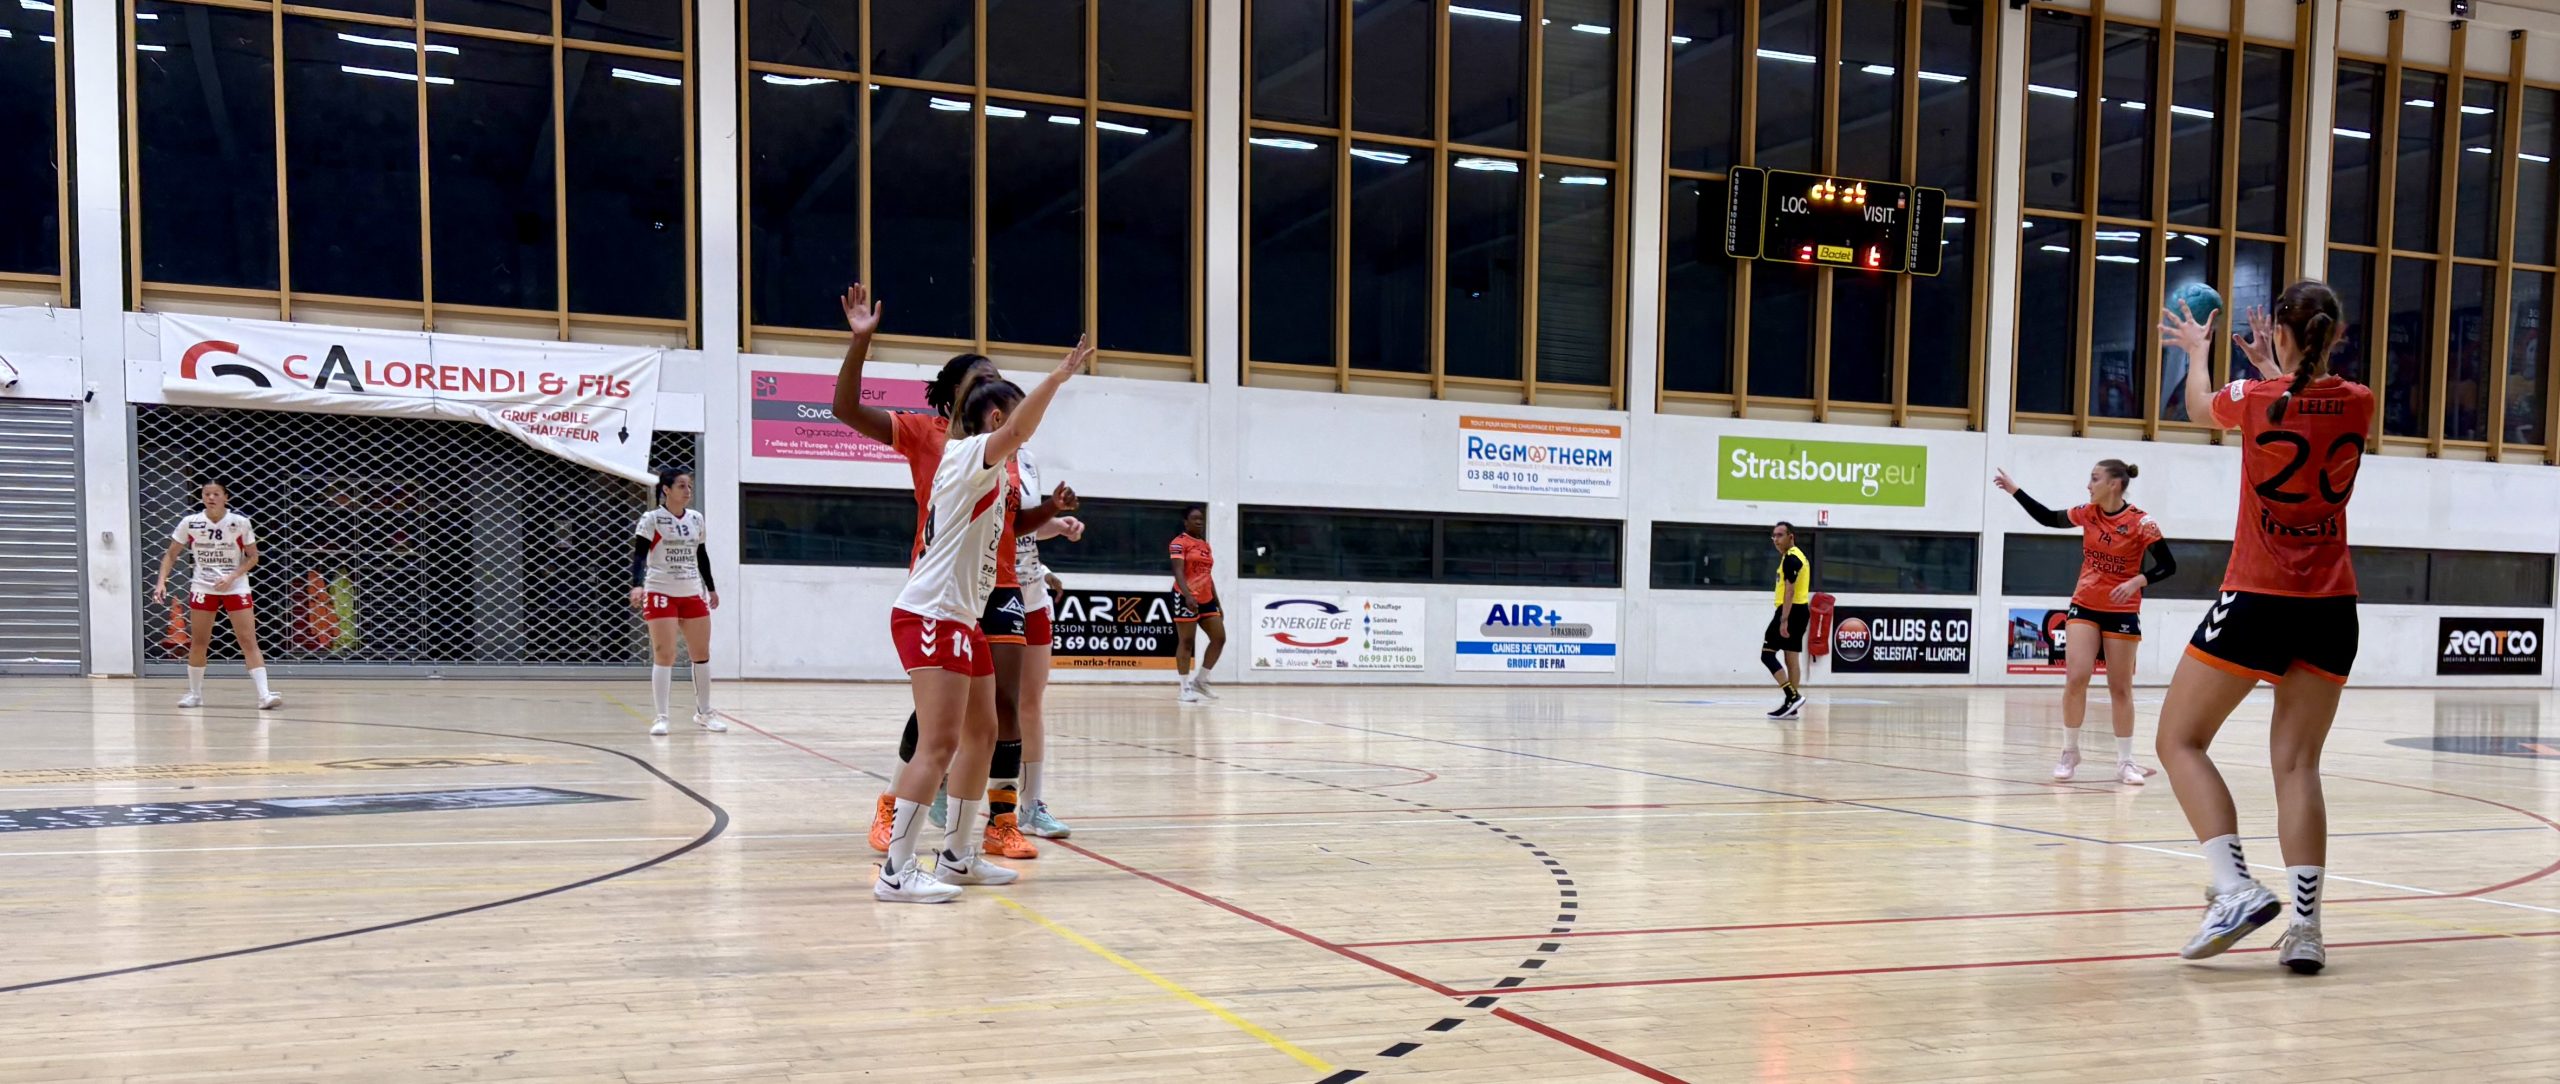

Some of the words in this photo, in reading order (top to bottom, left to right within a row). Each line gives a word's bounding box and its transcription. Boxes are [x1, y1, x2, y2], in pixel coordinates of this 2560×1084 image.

[1782, 196, 1810, 215] LOC.
[1864, 205, 1895, 224] VISIT.
[1820, 246, 1851, 260] Bodet
[538, 372, 568, 395] &
[578, 373, 631, 398] Fils
[501, 410, 538, 423] GRUE
[835, 442, 857, 450] 67960
[1731, 448, 1915, 497] Strasbourg.eu
[2255, 430, 2365, 504] 20
[1468, 470, 1479, 479] 03
[1482, 471, 1494, 480] 88
[1497, 471, 1509, 481] 40
[1513, 472, 1524, 482] 10
[1528, 473, 1538, 482] 10
[1548, 477, 1611, 486] www.regmatherm.fr
[207, 529, 222, 540] 78
[676, 525, 689, 536] 13
[654, 596, 668, 608] 13
[1486, 604, 1562, 626] AIR+
[1091, 625, 1118, 633] TOUS
[1124, 625, 1174, 635] SUPPORTS
[1261, 617, 1327, 630] SYNERGIE
[1330, 618, 1352, 631] GrE
[1872, 619, 1926, 642] CLUBS
[1930, 620, 1942, 642] &
[1946, 620, 1968, 642] CO
[1550, 628, 1587, 637] STRASBOURG
[952, 631, 972, 662] 14
[1066, 636, 1085, 650] 69
[1089, 636, 1109, 650] 06
[1113, 637, 1132, 650] 07
[1136, 637, 1157, 651] 00
[1492, 643, 1520, 653] GAINES
[1522, 644, 1531, 653] DE
[1533, 645, 1580, 654] VENTILATION
[1841, 640, 1864, 648] 2000
[1406, 655, 1416, 663] 09
[1873, 647, 1918, 660] SELESTAT
[1926, 647, 1966, 661] ILLKIRCH
[1507, 658, 1537, 668] GROUPE
[1539, 658, 1548, 668] DE
[1550, 659, 1565, 669] PRA
